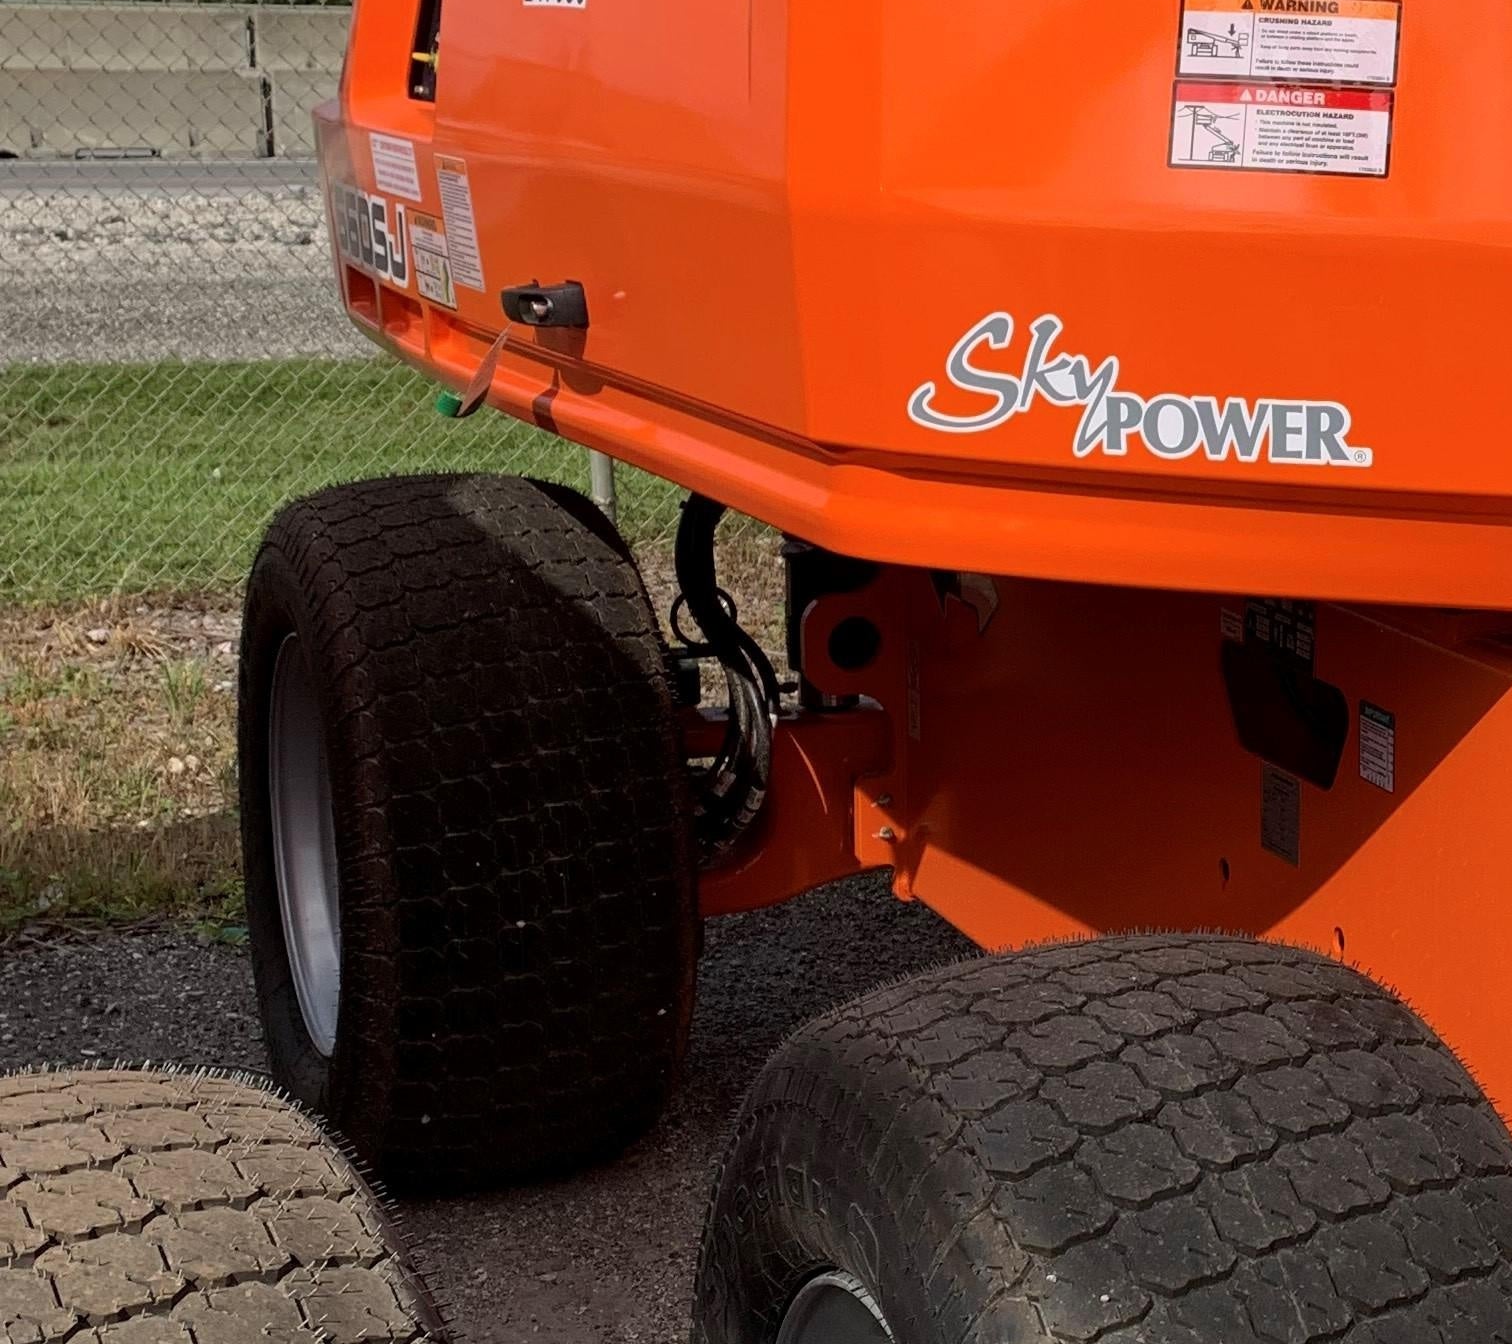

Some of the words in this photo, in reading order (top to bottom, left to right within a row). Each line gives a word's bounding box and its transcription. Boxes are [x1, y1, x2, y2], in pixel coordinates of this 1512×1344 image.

[1258, 17, 1299, 25] CRUSHING
[1301, 19, 1333, 27] HAZARD
[1255, 89, 1326, 105] DANGER
[1256, 109, 1320, 118] ELECTROCUTION
[1322, 112, 1354, 120] HAZARD
